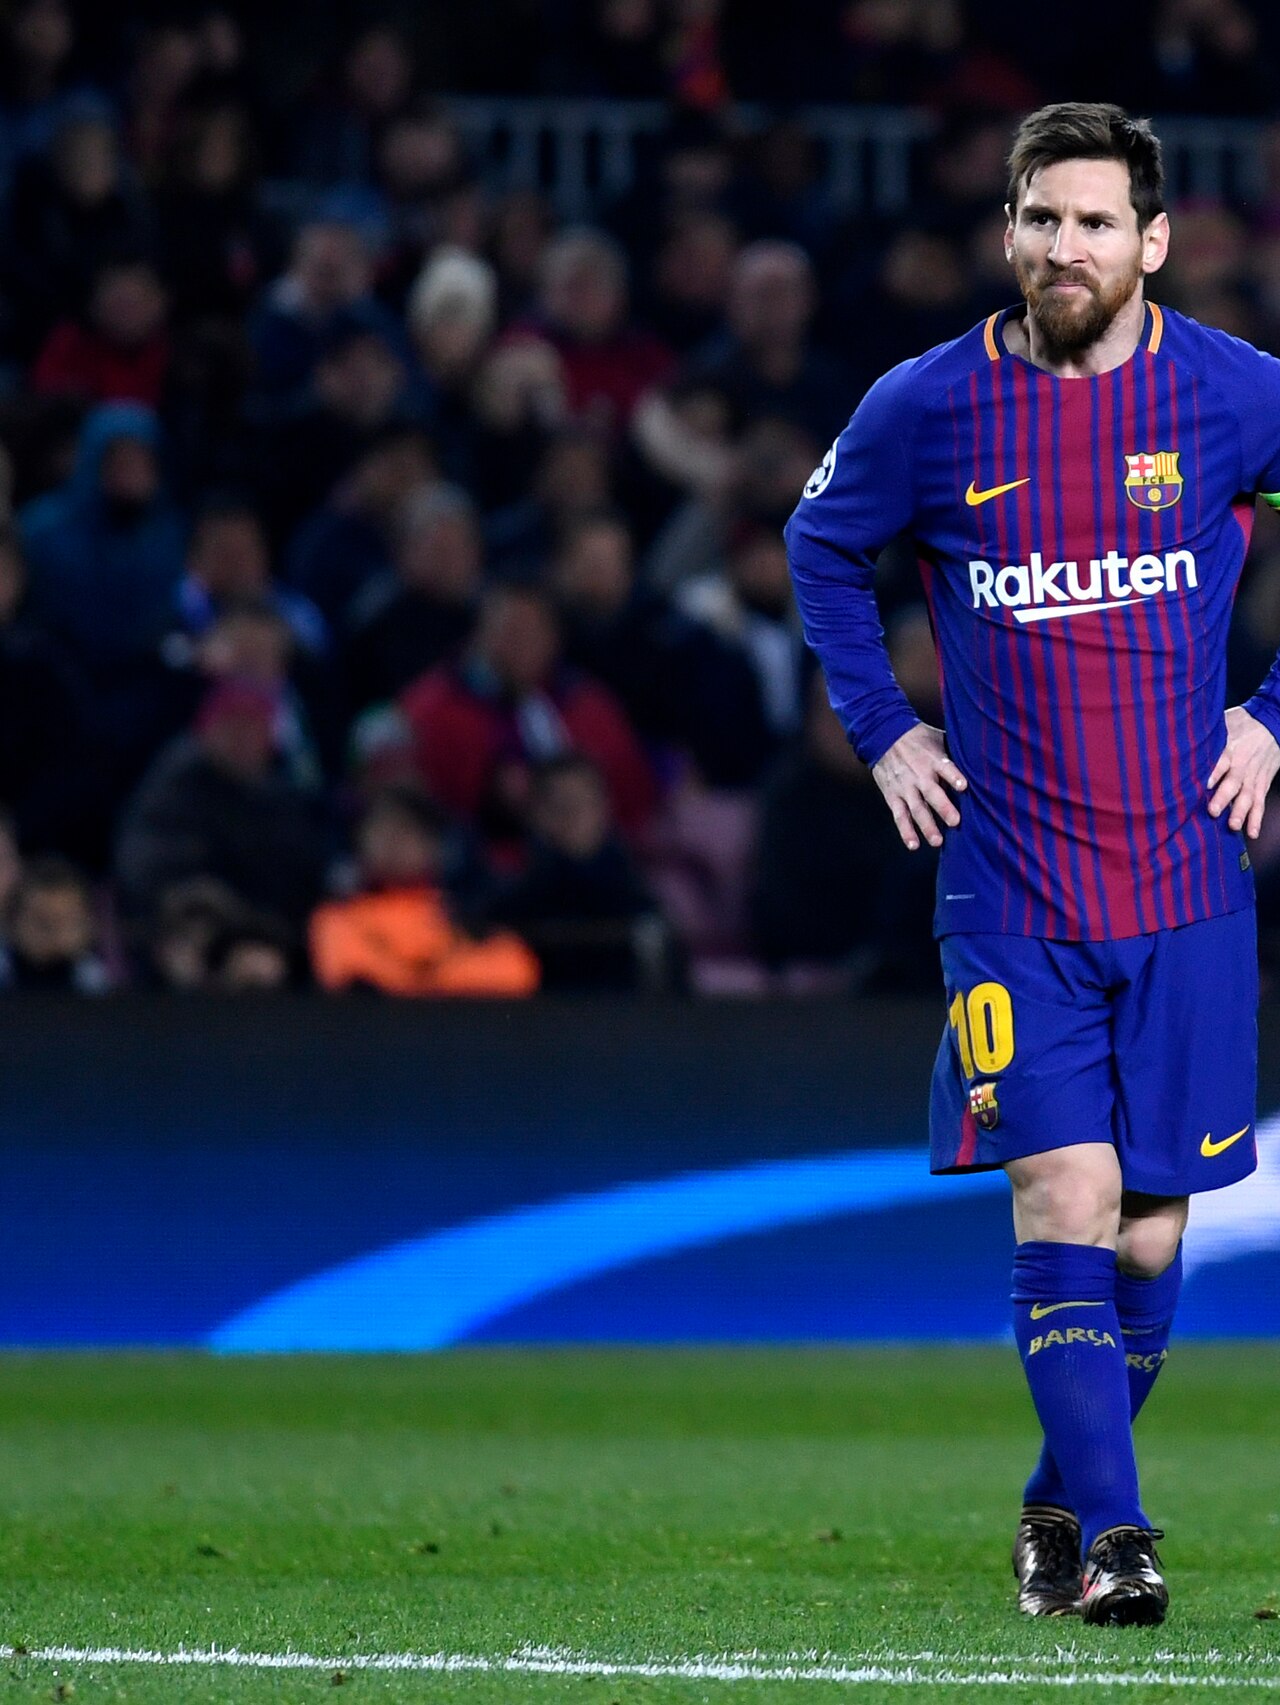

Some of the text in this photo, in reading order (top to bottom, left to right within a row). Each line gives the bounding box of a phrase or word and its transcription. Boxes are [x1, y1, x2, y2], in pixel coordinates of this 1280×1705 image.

[969, 550, 1198, 608] Rakuten
[949, 982, 1015, 1079] 10
[1029, 1327, 1116, 1355] BARÇA
